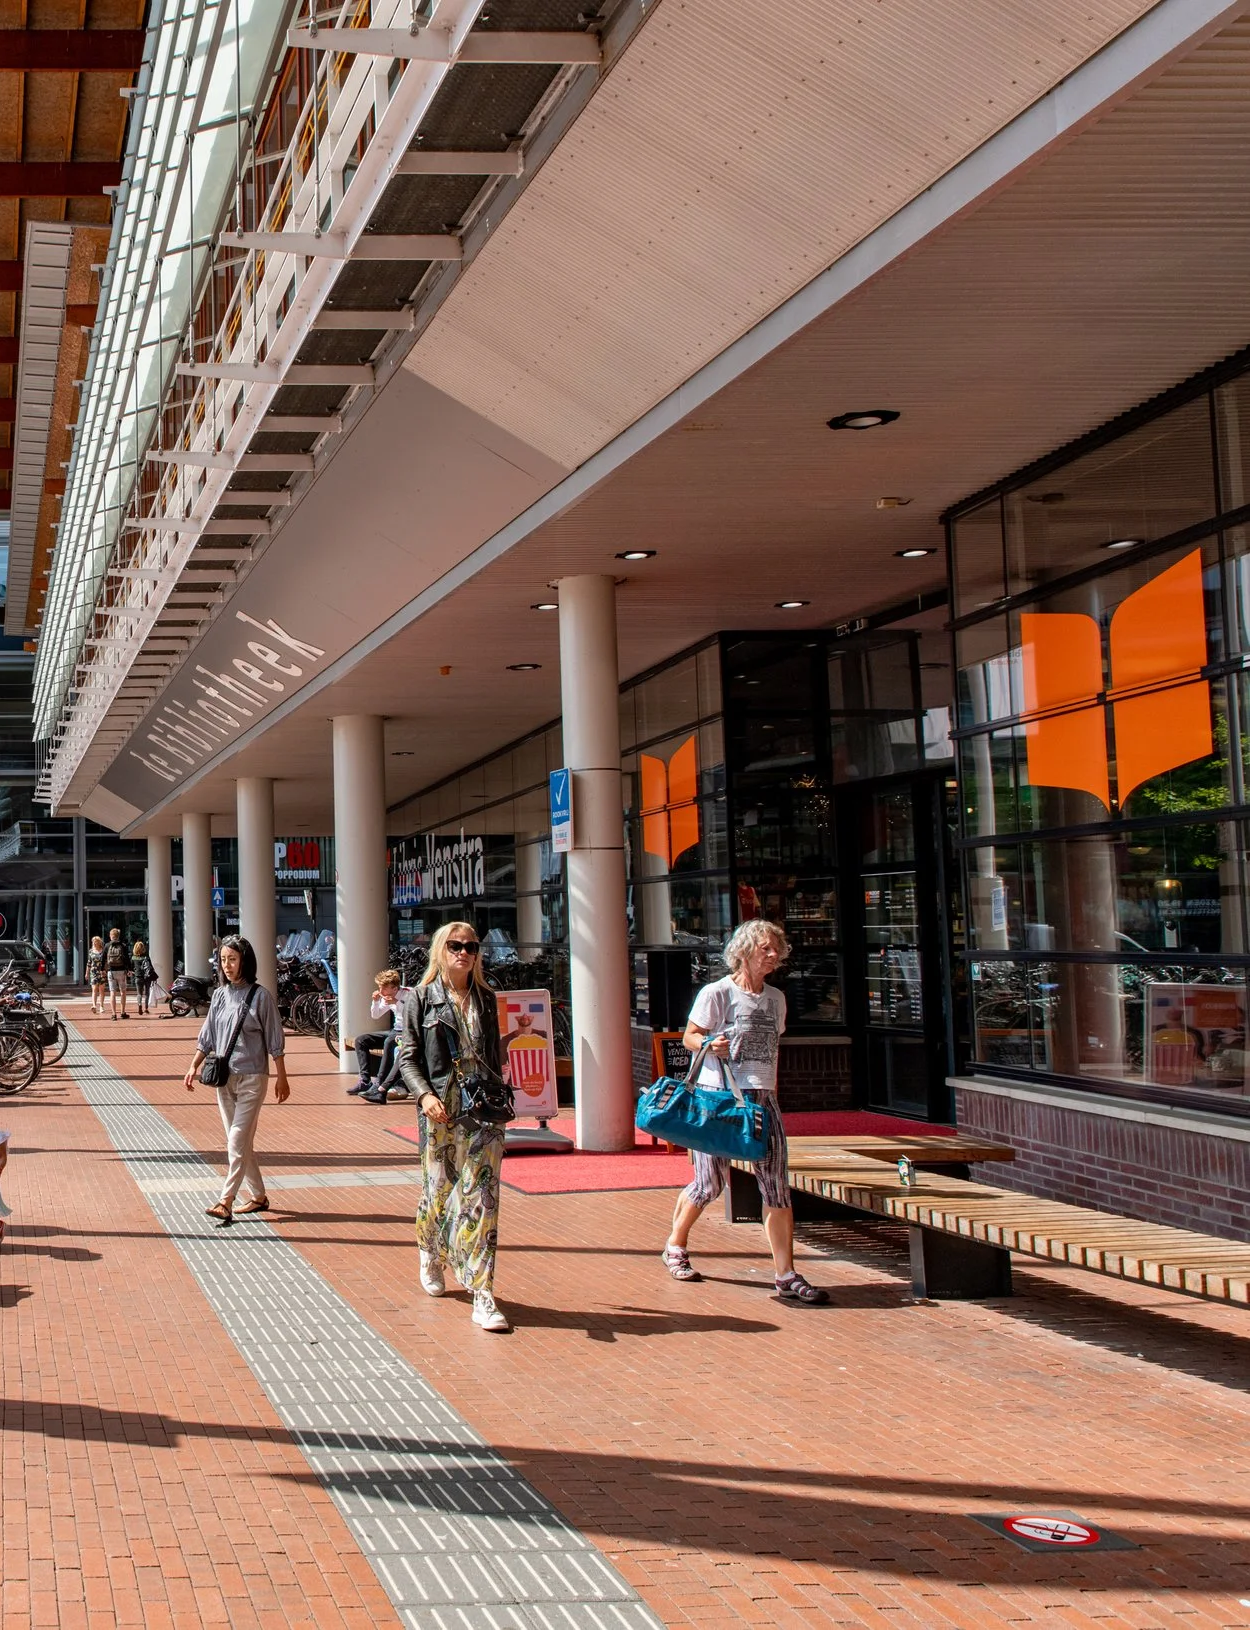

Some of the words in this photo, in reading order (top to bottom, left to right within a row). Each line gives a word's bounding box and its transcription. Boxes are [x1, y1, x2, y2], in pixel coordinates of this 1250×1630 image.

[147, 610, 326, 765] Bibliotheek
[274, 841, 321, 869] P60
[424, 826, 485, 899] Venstra
